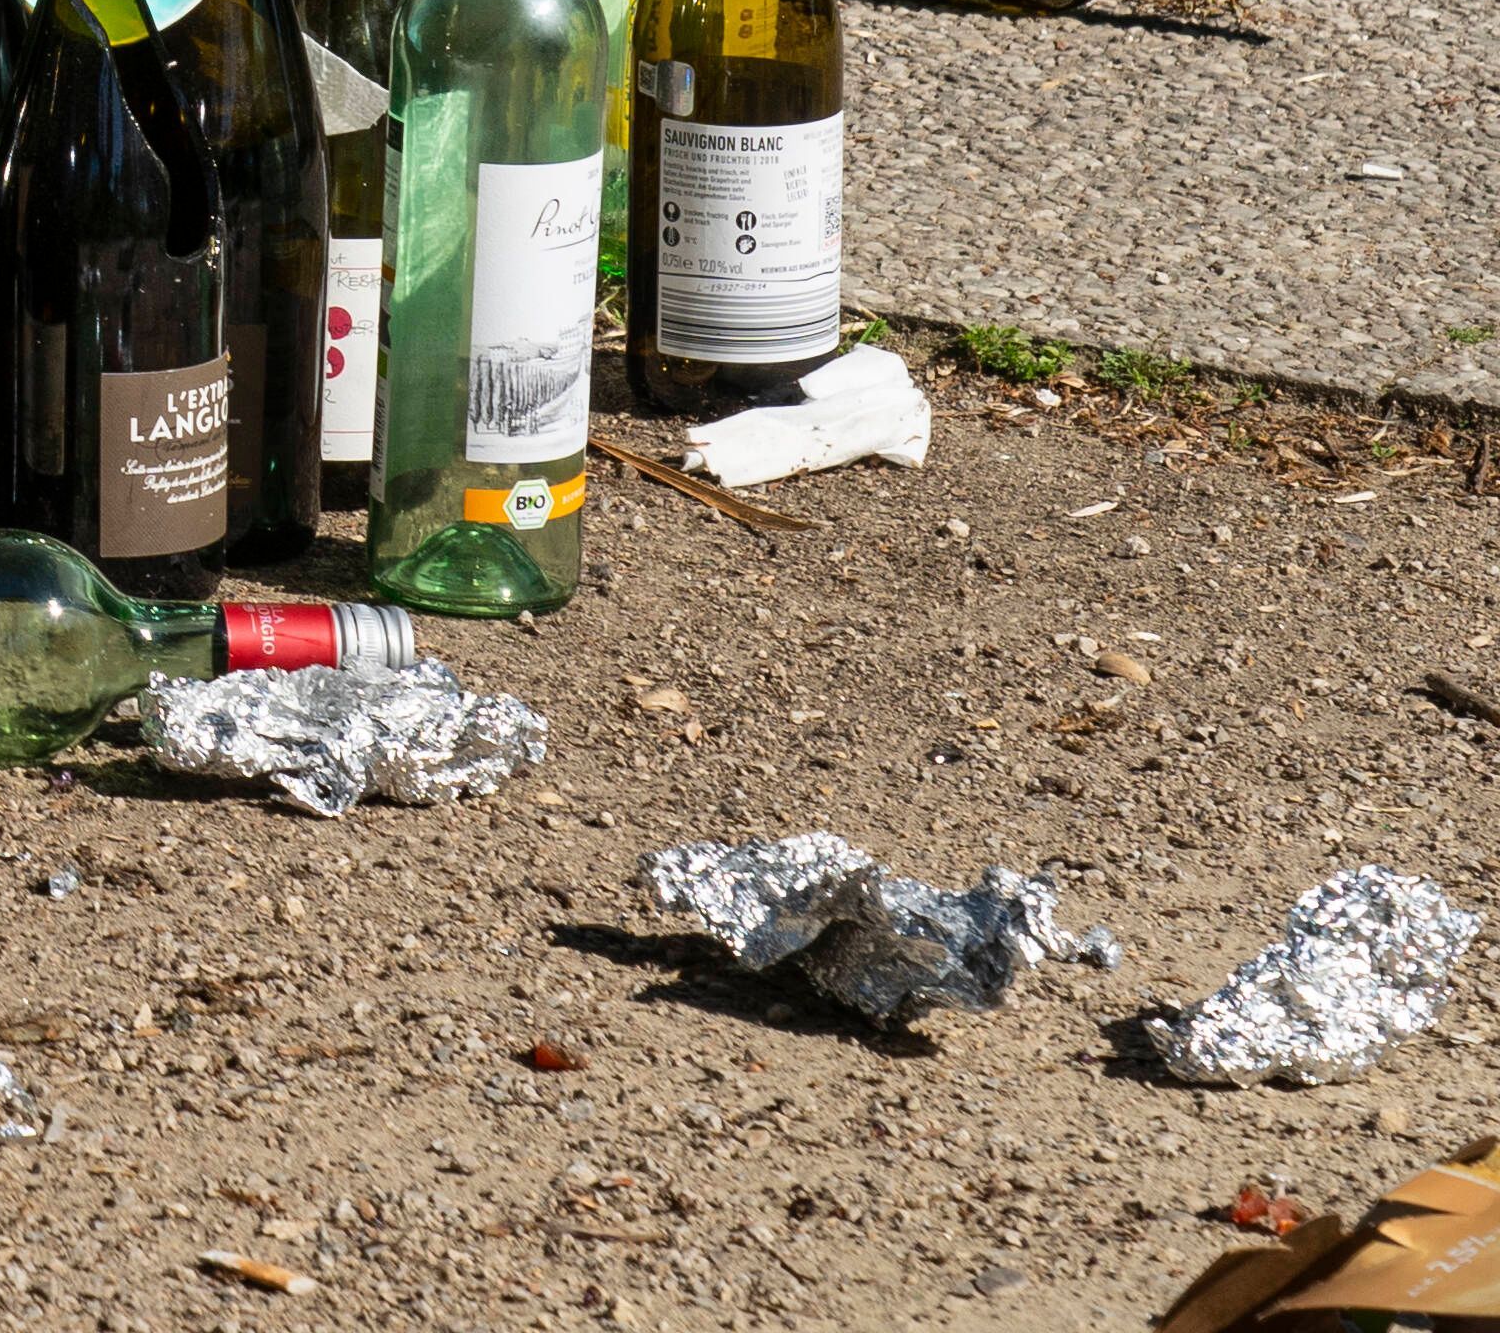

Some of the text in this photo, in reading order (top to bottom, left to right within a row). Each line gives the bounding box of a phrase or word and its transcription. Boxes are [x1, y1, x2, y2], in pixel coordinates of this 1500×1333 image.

[664, 129, 784, 152] SAUVIGNON BLANC
[664, 147, 690, 160] FRISCH
[691, 152, 708, 163] UND
[530, 198, 590, 239] Pinot
[516, 494, 546, 511] BIO
